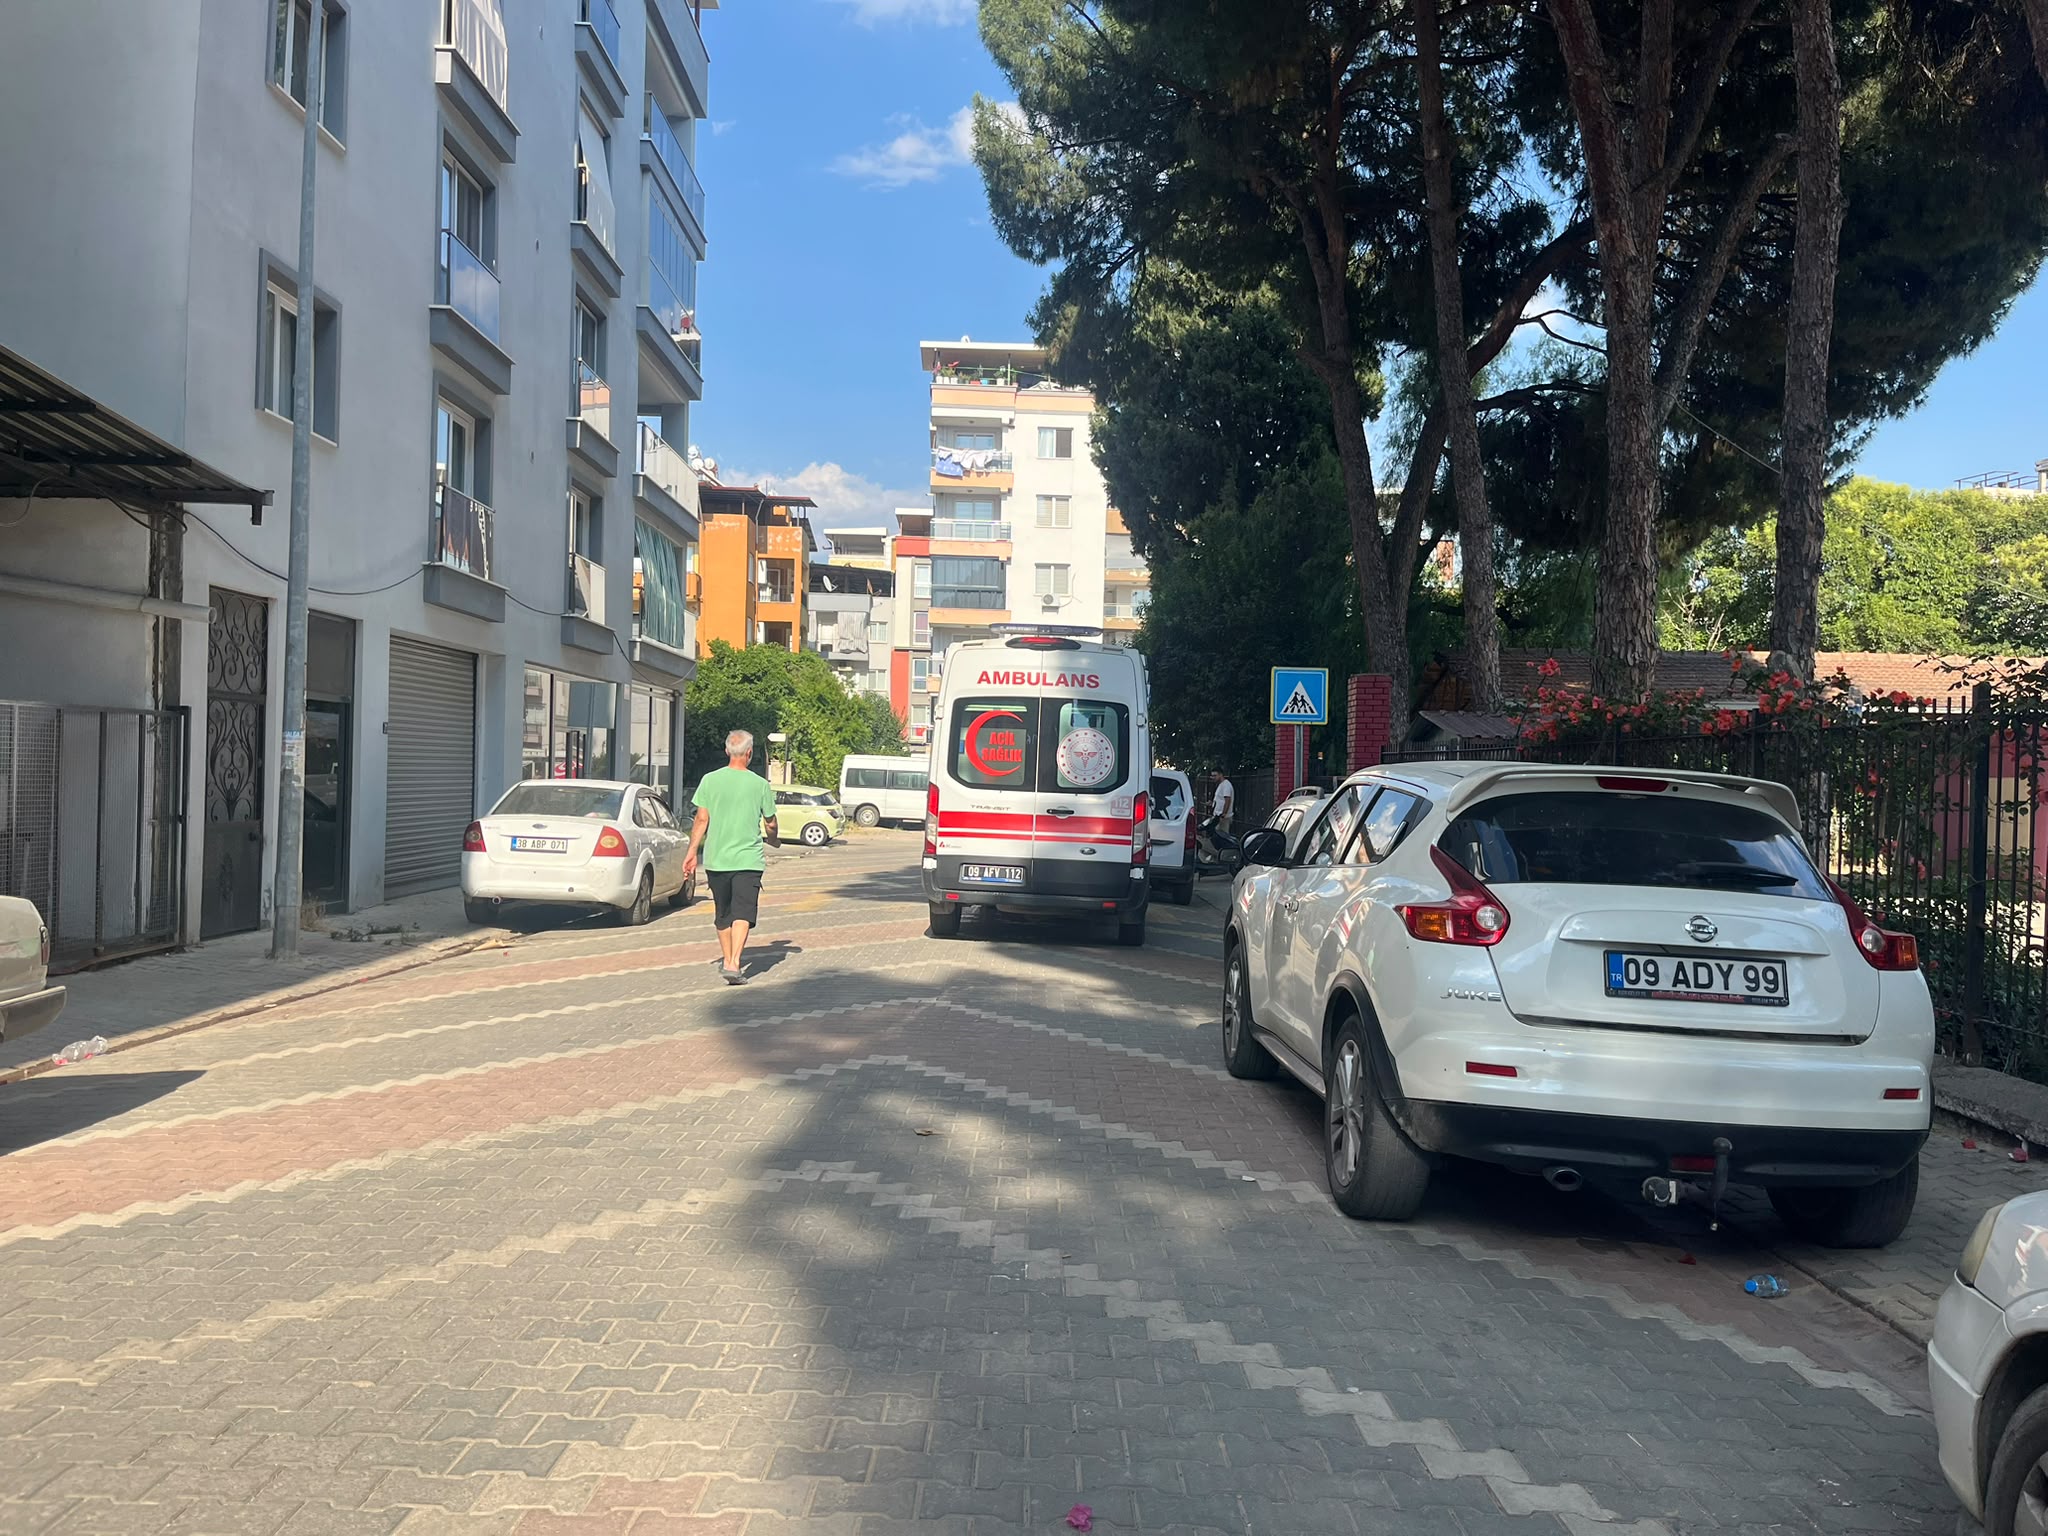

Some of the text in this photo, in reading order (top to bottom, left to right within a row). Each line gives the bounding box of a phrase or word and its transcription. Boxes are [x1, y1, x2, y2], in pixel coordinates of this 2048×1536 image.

[977, 671, 1100, 689] AMBULANS
[981, 746, 1022, 762] SAĞLIK
[517, 839, 565, 850] 38 ABP 071
[968, 866, 980, 877] 09
[1005, 868, 1021, 879] 112
[1611, 973, 1623, 982] TR
[1624, 957, 1779, 994] 09 ADY 99
[1440, 988, 1502, 1002] JUKE
